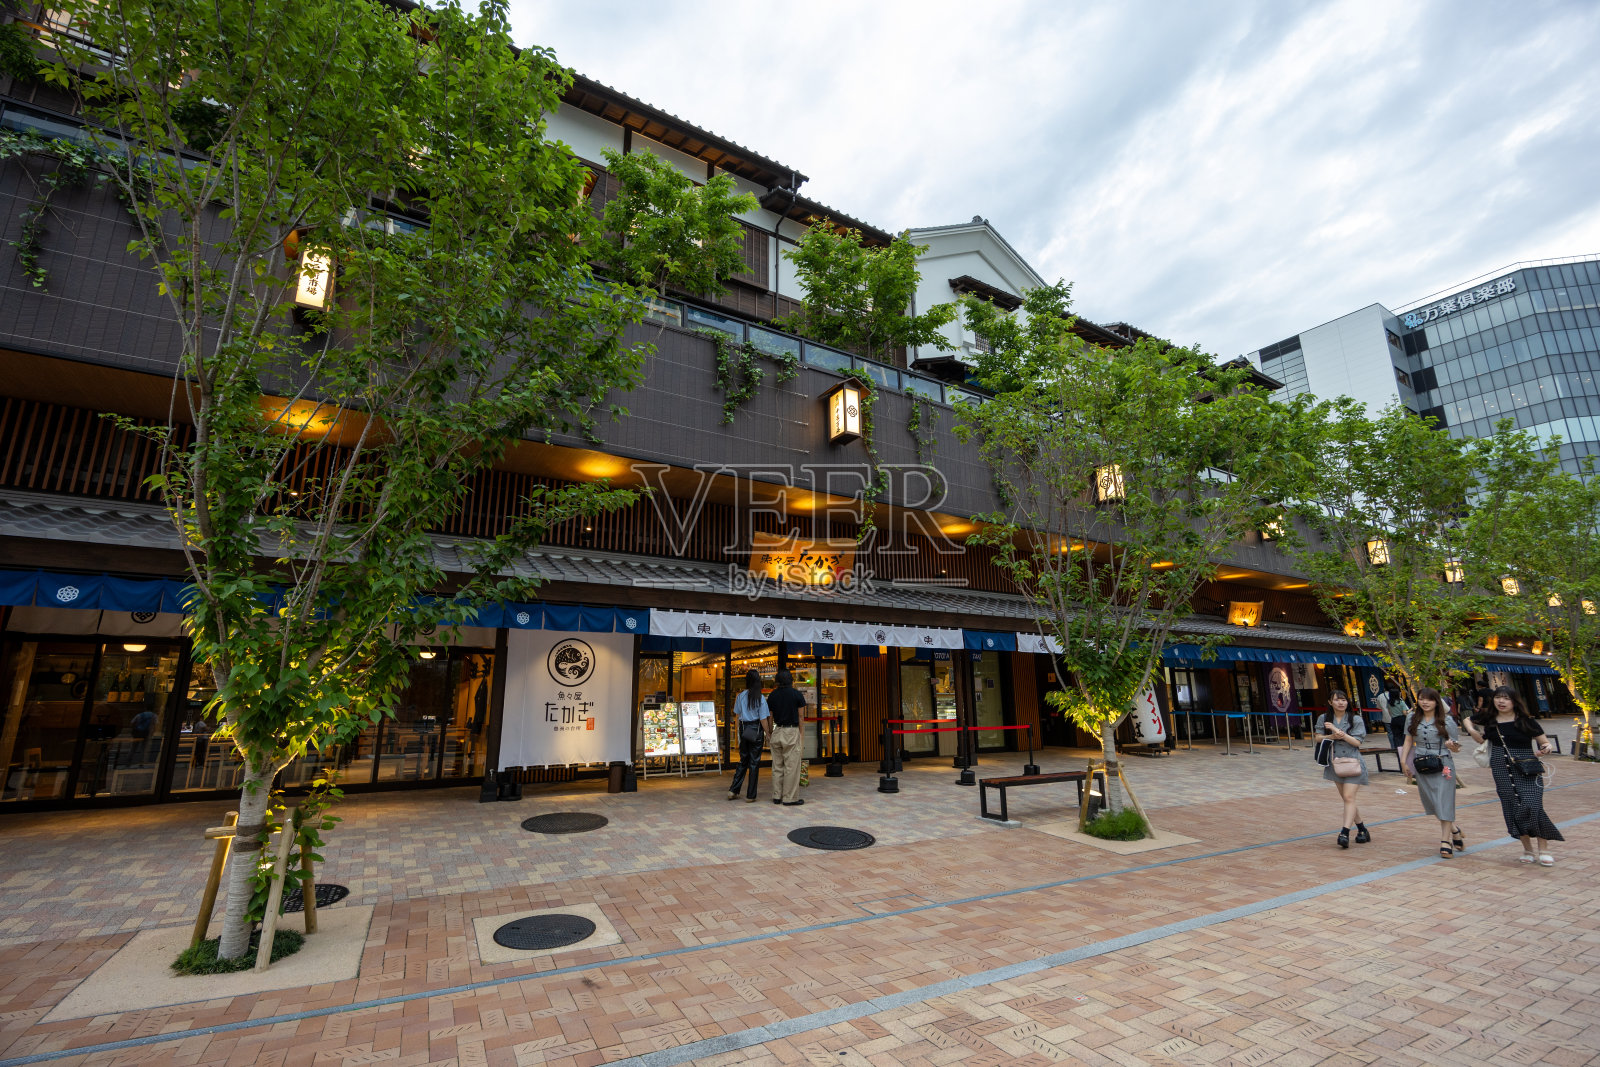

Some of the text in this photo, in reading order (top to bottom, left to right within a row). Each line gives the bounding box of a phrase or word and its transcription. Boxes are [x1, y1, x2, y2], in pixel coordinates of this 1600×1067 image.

[1421, 278, 1515, 322] 万葉倶楽部
[557, 691, 583, 701] 魚々屋
[544, 701, 594, 724] たかぎ
